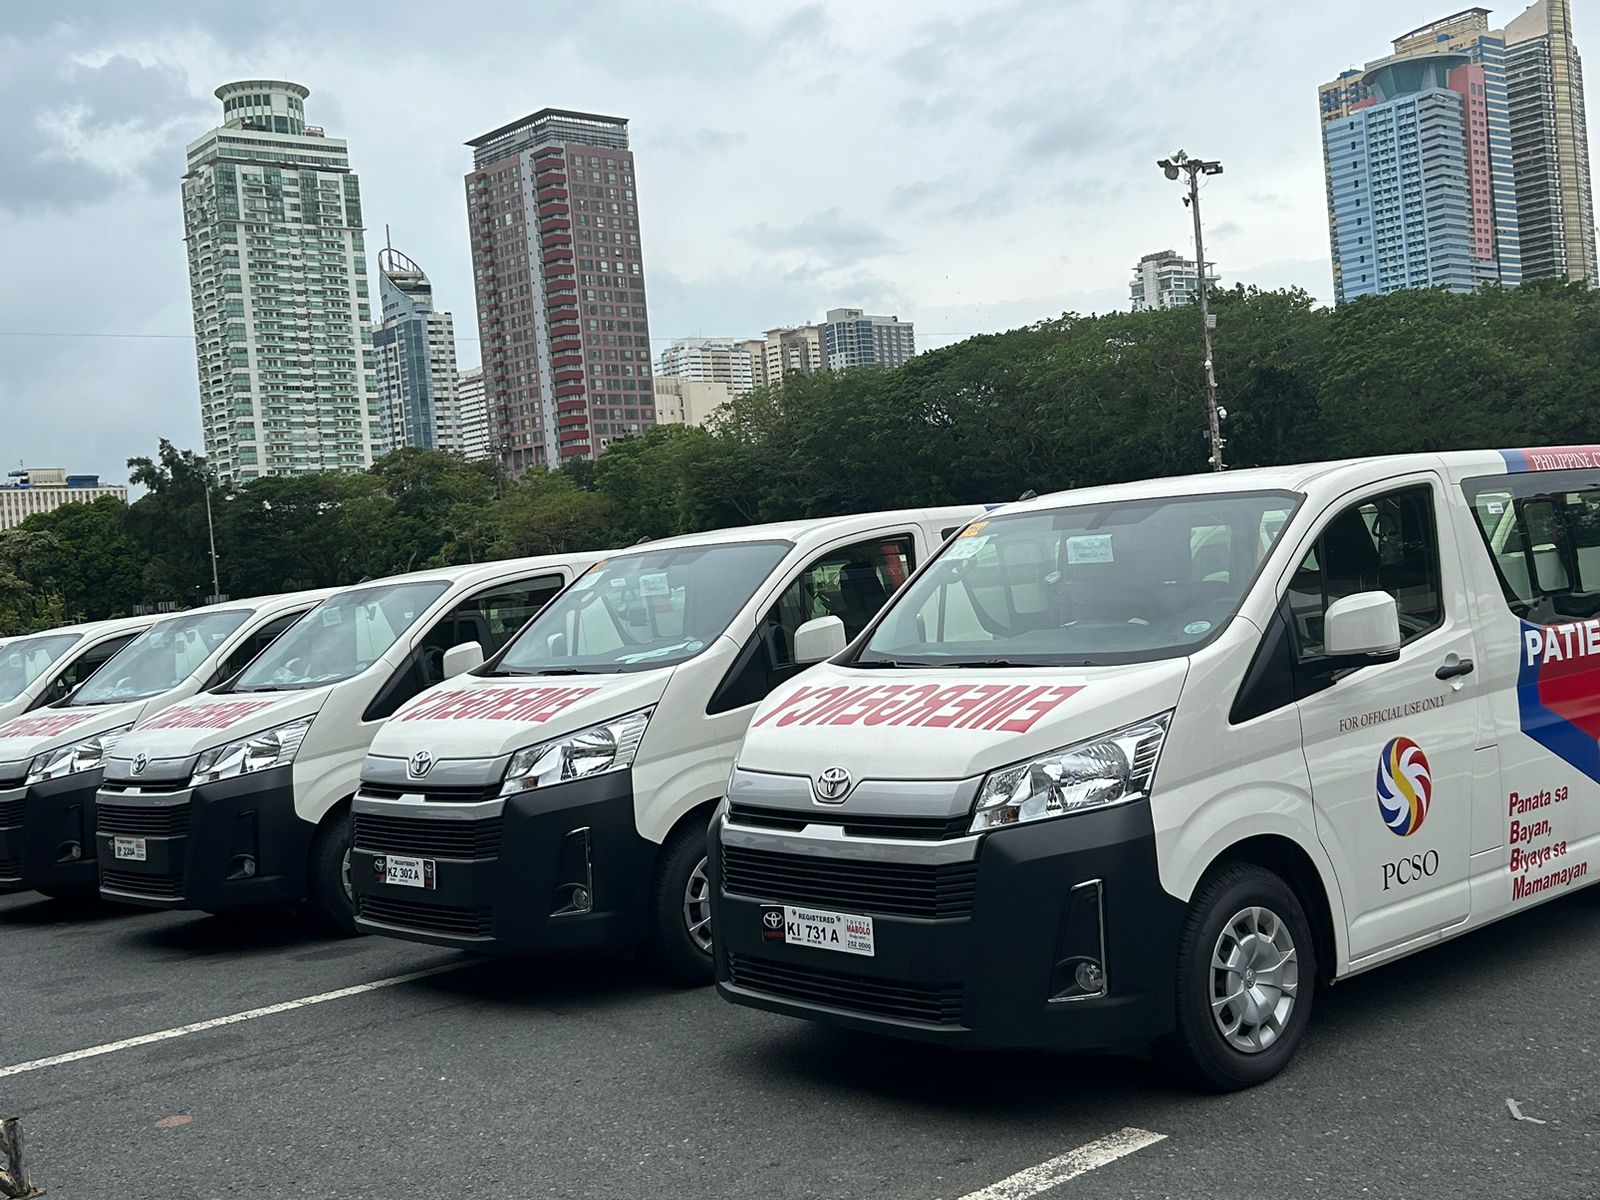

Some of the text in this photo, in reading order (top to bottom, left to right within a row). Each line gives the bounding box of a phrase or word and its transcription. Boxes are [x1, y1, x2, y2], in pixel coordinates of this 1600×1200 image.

[1531, 452, 1592, 471] PHILIPPINE
[1525, 619, 1600, 667] PATIE
[1339, 695, 1446, 732] FOR OFFICIAL USE ONLY
[1509, 786, 1568, 816] Panata sa
[1510, 819, 1552, 844] Bayan,
[1381, 849, 1439, 891] PCSO
[1510, 840, 1567, 873] Biyaya sa
[1512, 861, 1587, 901] Mamamayan
[798, 913, 834, 923] REGISTERED
[805, 925, 826, 940] 731
[830, 929, 839, 943] A
